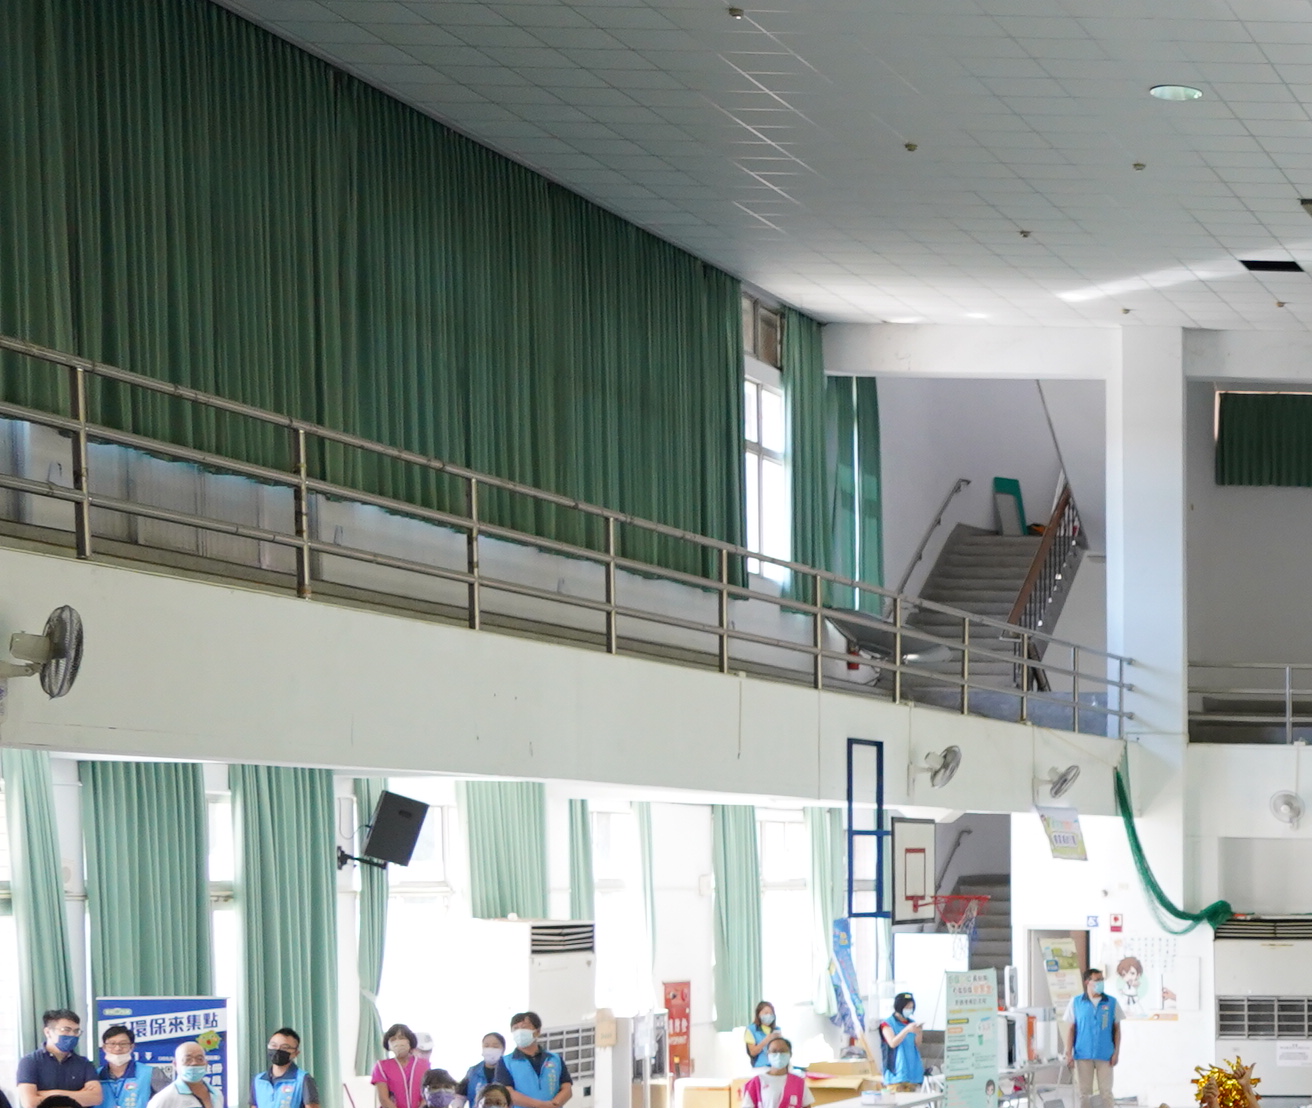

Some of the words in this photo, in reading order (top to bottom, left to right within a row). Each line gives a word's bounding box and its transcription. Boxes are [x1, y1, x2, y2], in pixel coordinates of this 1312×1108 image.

[108, 1011, 219, 1039] 環保來集點
